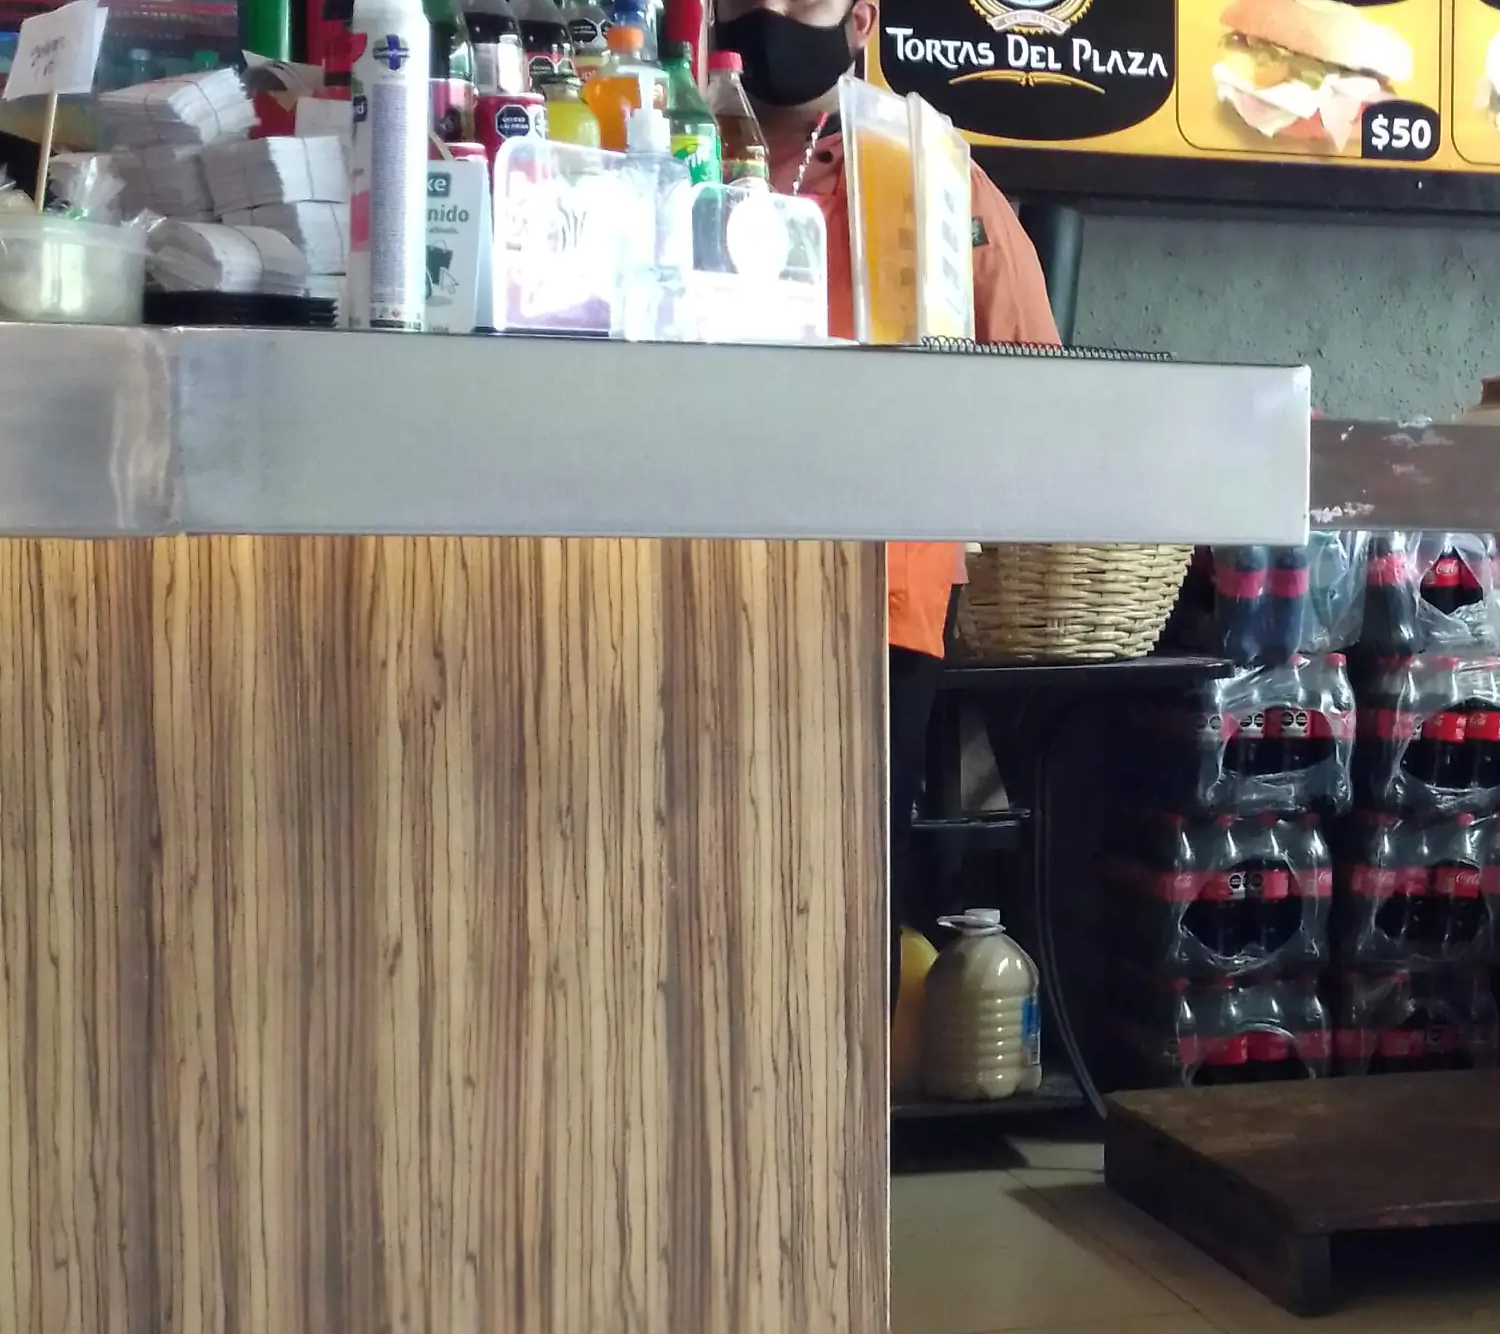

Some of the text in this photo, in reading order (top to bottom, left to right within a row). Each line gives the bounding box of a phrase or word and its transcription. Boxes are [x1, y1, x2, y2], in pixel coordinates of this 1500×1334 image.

[885, 27, 994, 67] TORTAS
[1073, 38, 1168, 77] PLAZA
[1370, 118, 1432, 150] $50
